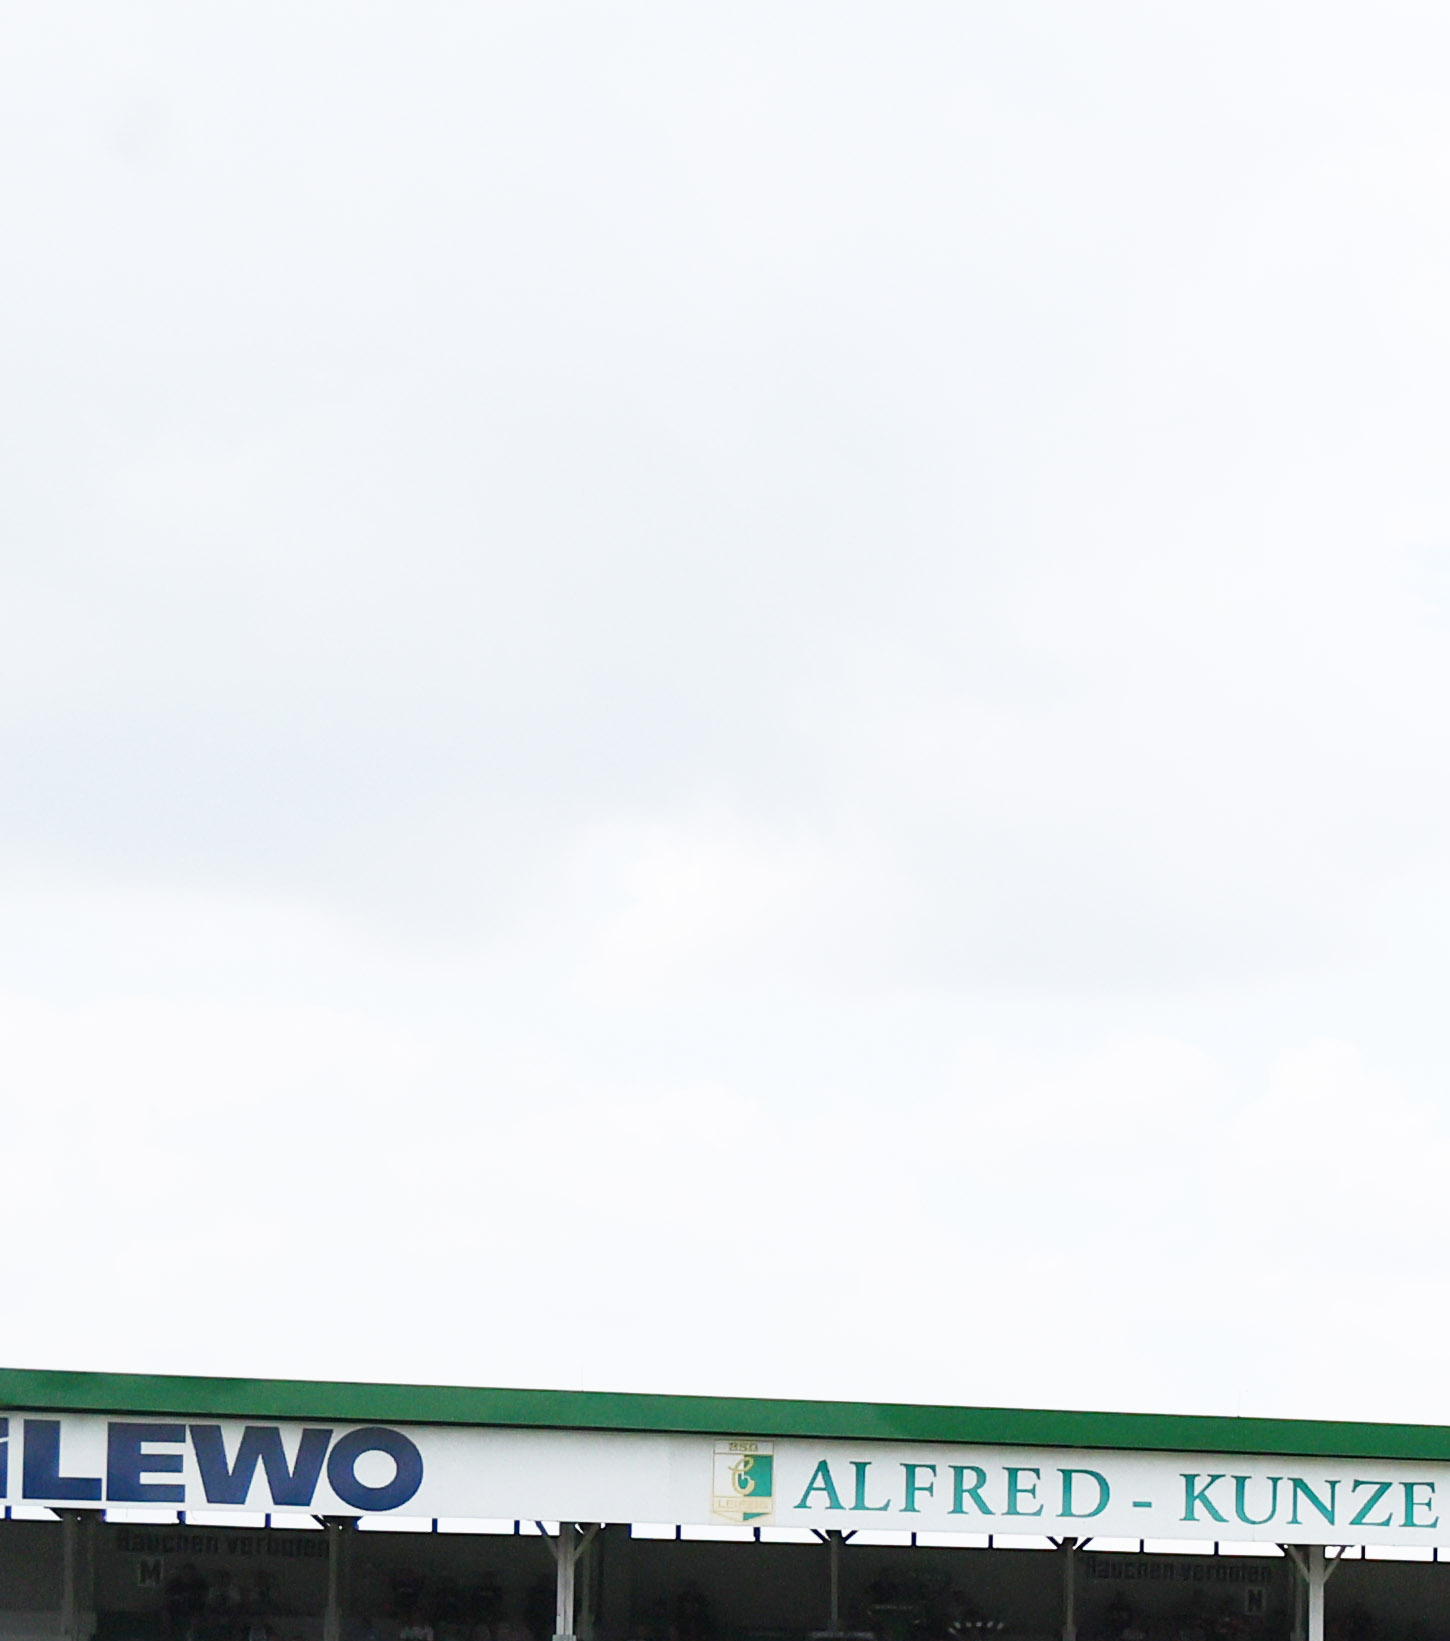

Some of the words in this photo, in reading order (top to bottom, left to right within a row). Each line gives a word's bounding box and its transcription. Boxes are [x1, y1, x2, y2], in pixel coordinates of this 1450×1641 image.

[22, 1418, 423, 1512] LEWO
[793, 1459, 1111, 1518] ALFRED
[1178, 1473, 1440, 1529] KUNZE
